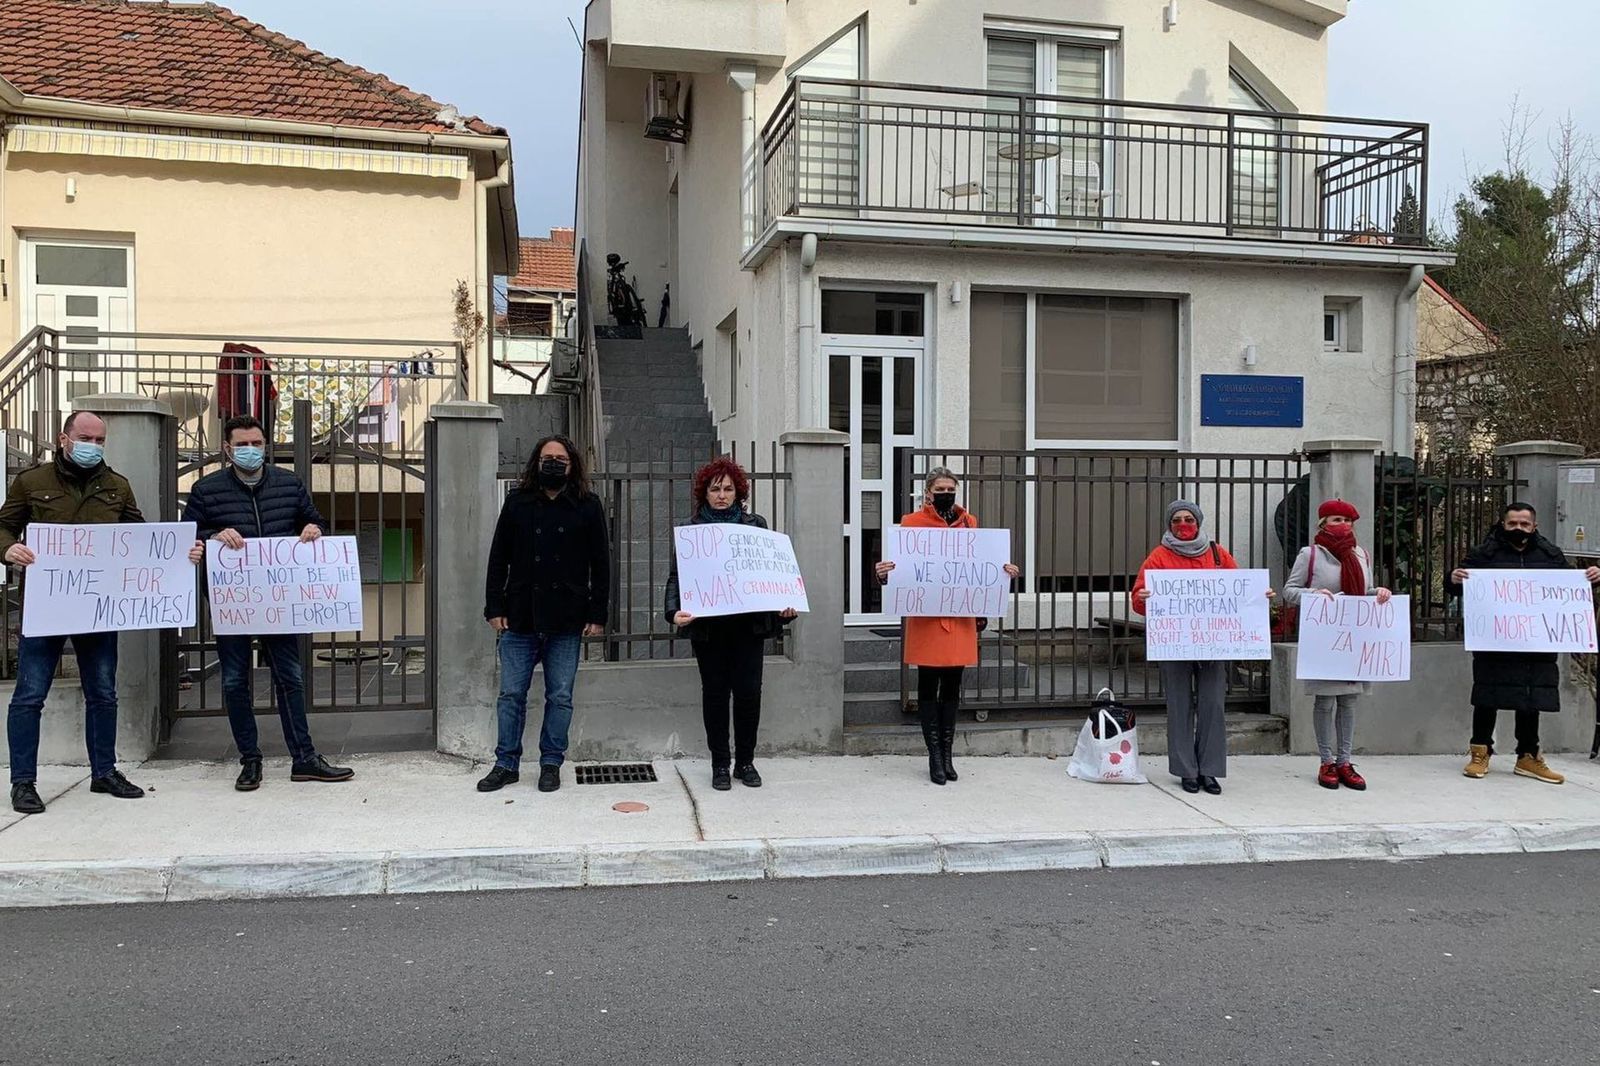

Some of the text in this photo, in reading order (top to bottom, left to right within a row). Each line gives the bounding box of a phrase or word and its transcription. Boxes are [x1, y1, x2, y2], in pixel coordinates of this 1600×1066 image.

[29, 527, 96, 557] THERE
[149, 530, 177, 560] NO
[680, 526, 724, 560] STOP
[728, 533, 778, 550] GENOCIDE
[895, 529, 977, 559] TOGETHER
[217, 538, 356, 573] GENOCIDE
[731, 547, 791, 562] DENIAL AND
[212, 566, 358, 586] MUST NOT BE THE
[724, 559, 800, 576] GLORIFICATION
[914, 561, 999, 586] WE STAND
[122, 567, 164, 594] FOR
[683, 591, 693, 600] OF
[694, 574, 743, 608] WAR
[1150, 574, 1250, 600] JUDGEMENTS OF
[1466, 578, 1591, 607] NO MORE DIVISION
[213, 584, 339, 605] BASIS OF NEW
[895, 584, 1003, 616] FOR PEACE!
[1149, 597, 1238, 617] the EUROPEAN
[92, 589, 193, 629] MISTAKES!
[219, 608, 255, 625] MAP
[266, 607, 285, 624] OF
[1305, 594, 1395, 629] ZAJEDNO
[1148, 617, 1242, 631] COURT OF HUMAN
[1466, 613, 1486, 638] NO
[1493, 613, 1538, 642] MORE
[1149, 631, 1184, 647] RIGHT
[1192, 631, 1223, 645] BASIC
[1229, 631, 1247, 643] FOR
[1193, 644, 1208, 659] OF
[1331, 631, 1353, 652] ZA
